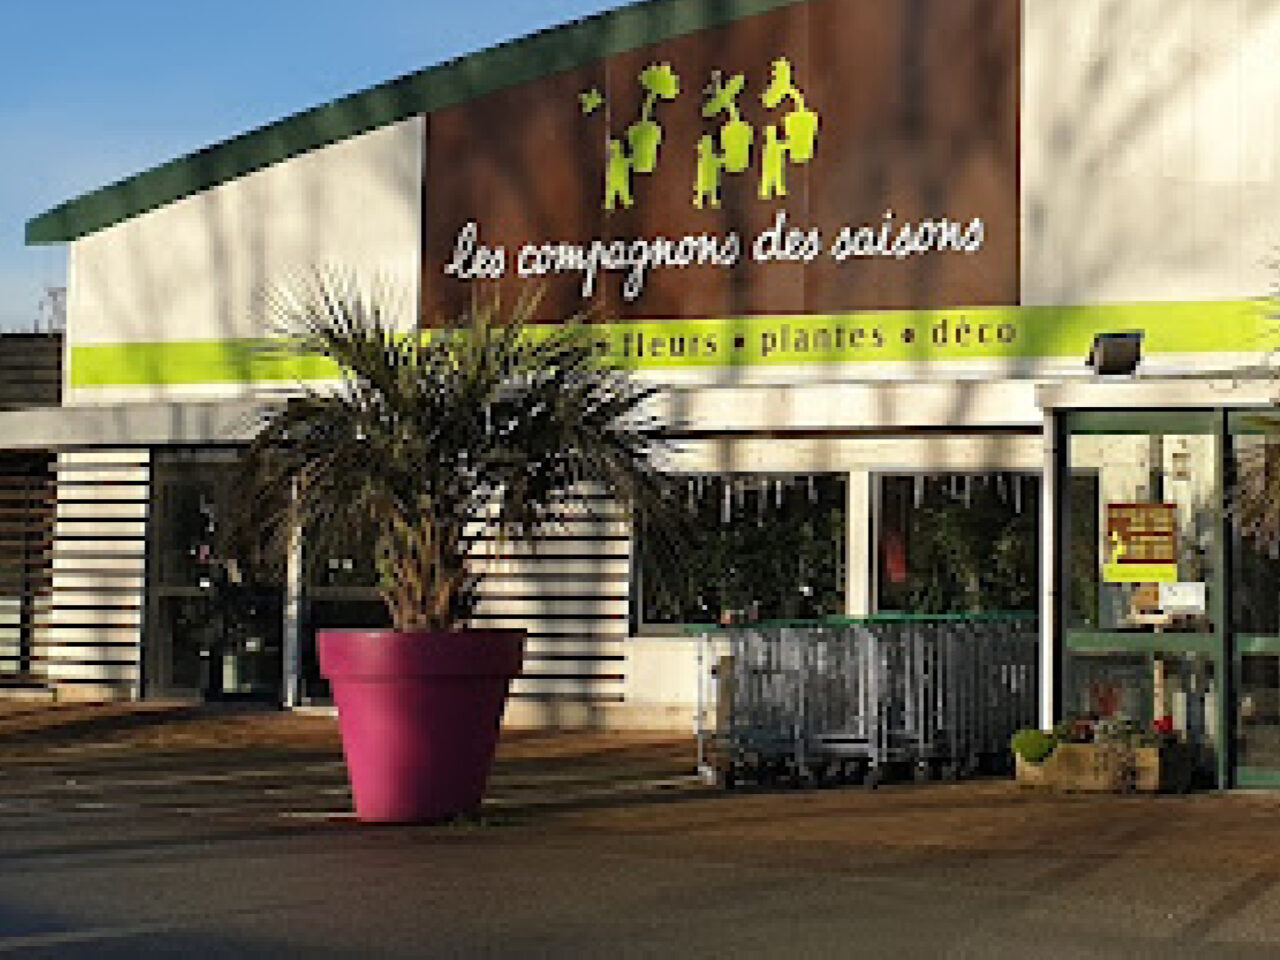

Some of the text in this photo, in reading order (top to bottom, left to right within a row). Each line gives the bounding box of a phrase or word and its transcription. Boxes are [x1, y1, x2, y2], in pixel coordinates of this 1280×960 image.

[444, 209, 985, 300] les compagnons des saisons
[623, 315, 1017, 357] fleurs plantes déco
